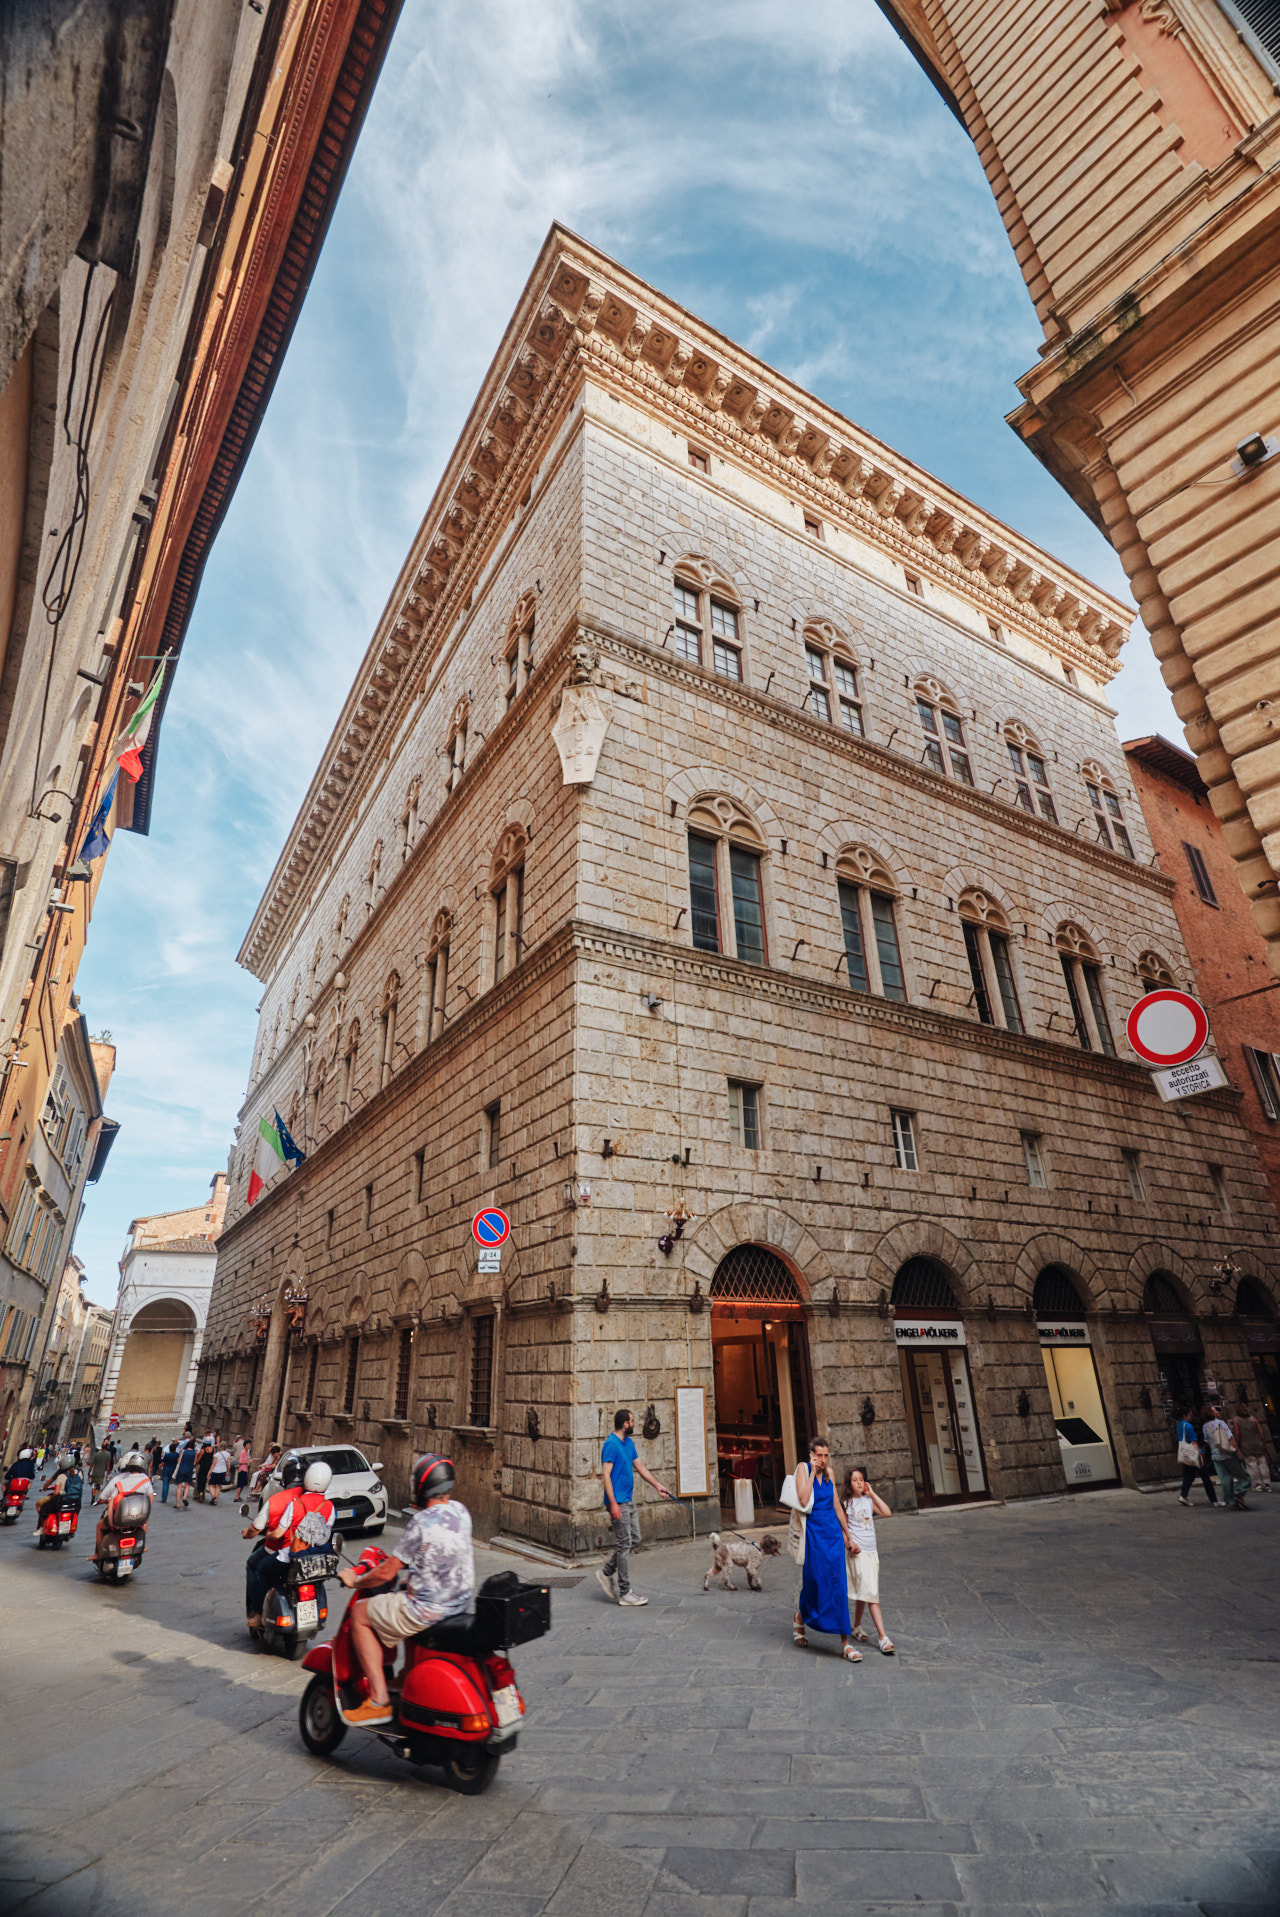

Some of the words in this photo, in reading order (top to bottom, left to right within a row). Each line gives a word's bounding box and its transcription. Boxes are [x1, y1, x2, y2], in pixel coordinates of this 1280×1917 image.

[1168, 1070, 1209, 1088] autorizzati
[1171, 1064, 1200, 1078] eccetto
[1181, 1079, 1212, 1095] STORICA
